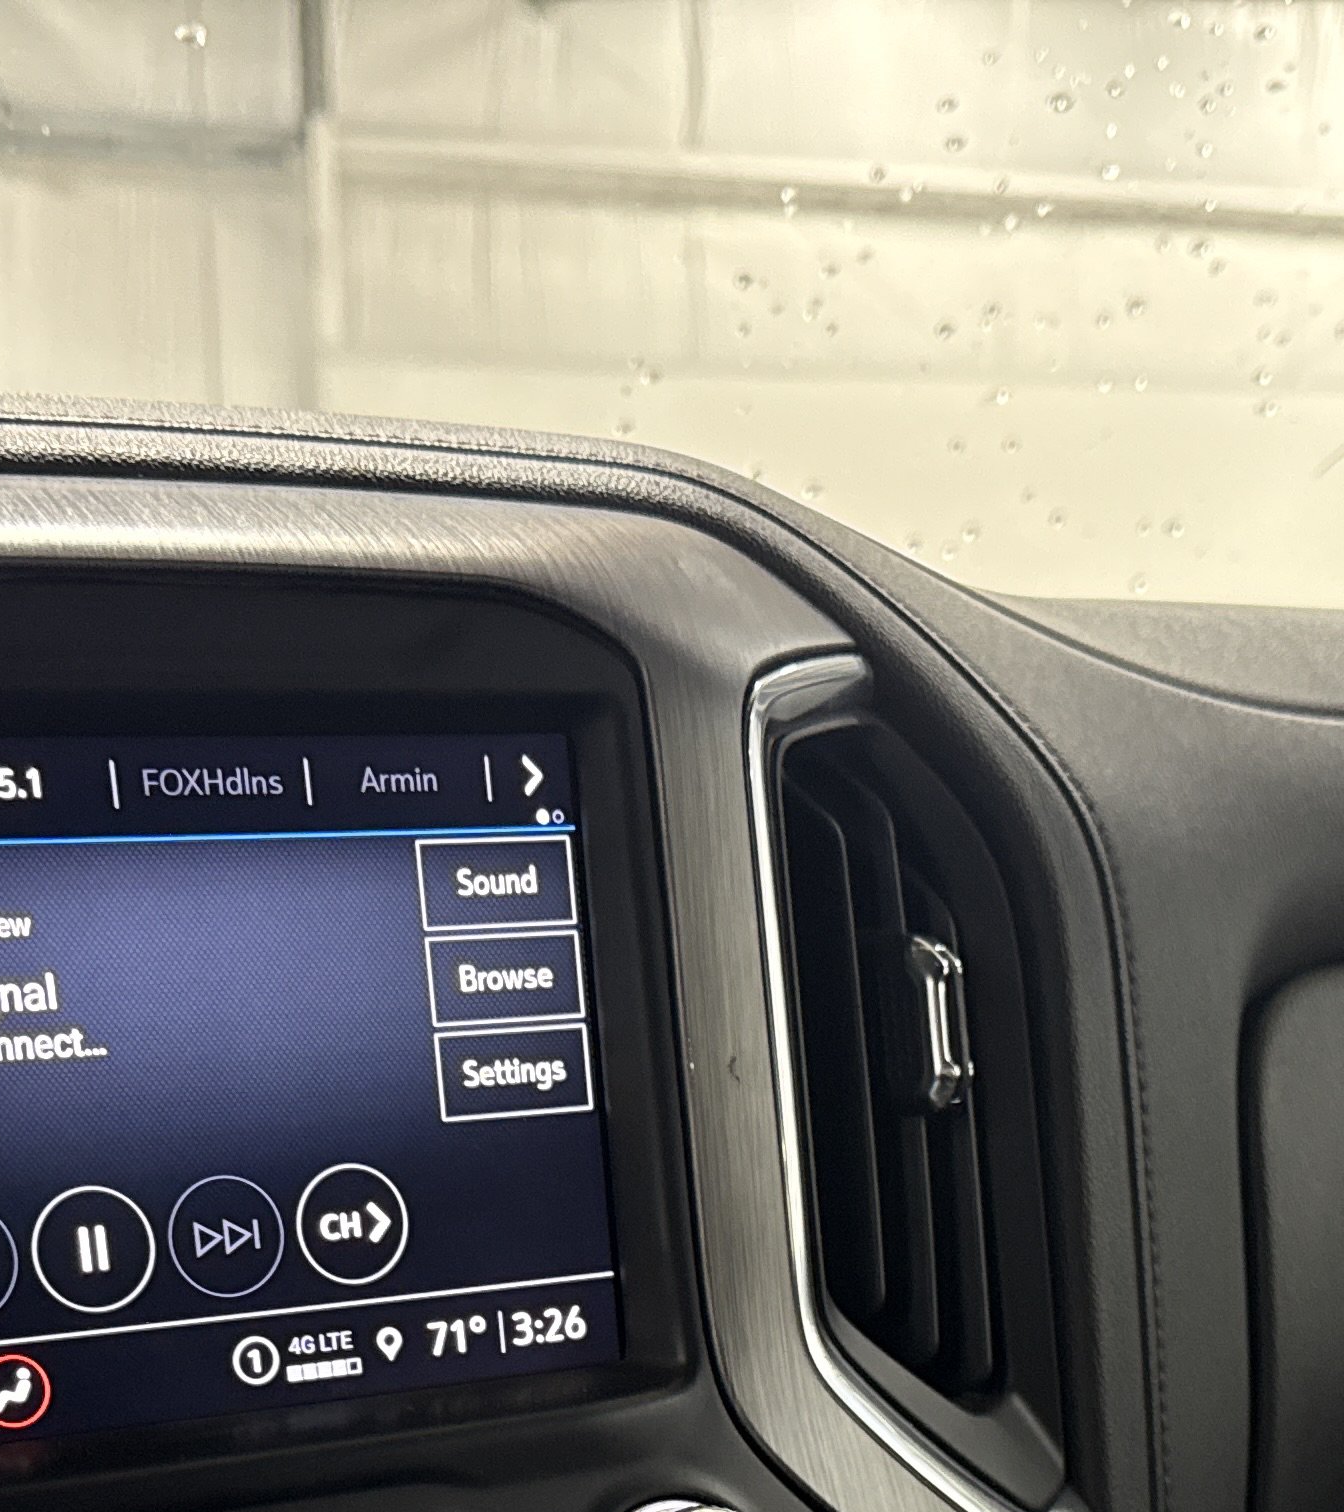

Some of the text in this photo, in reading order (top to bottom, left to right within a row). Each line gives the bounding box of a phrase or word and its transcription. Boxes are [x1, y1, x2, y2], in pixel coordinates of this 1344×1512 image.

[142, 767, 284, 797] FOXHdlns
[360, 766, 438, 793] Armin
[456, 864, 538, 897] Sound
[458, 963, 554, 993] Browse
[462, 1057, 567, 1091] Settings
[319, 1210, 363, 1241] CH
[426, 1315, 487, 1357] 71°
[511, 1304, 587, 1347] 3:26
[288, 1330, 354, 1355] 4G LTE
